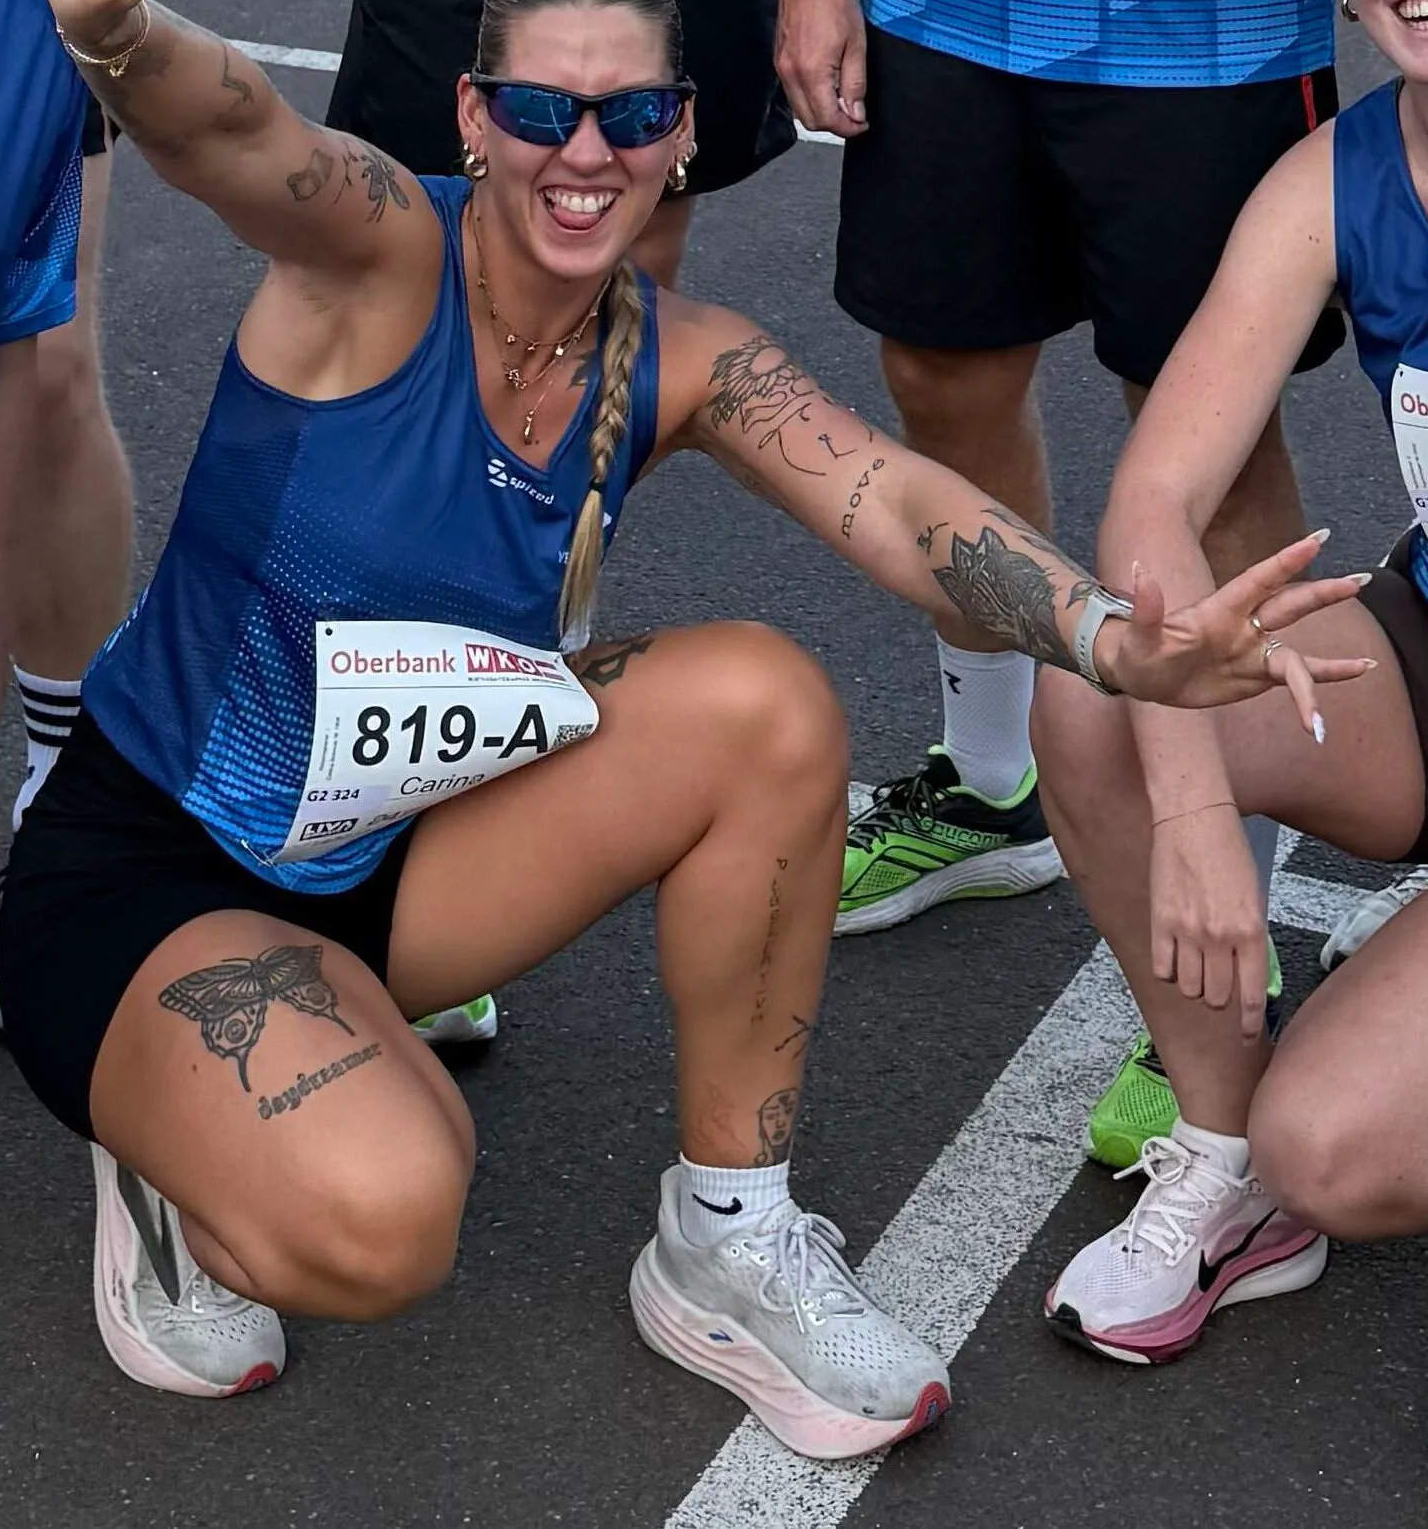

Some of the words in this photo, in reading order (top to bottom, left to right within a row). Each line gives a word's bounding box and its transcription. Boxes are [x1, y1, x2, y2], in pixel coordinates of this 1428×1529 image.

[330, 649, 457, 675] Oberbank
[467, 645, 537, 677] WKO
[352, 703, 549, 767] 819-A
[307, 789, 329, 803] G2
[332, 788, 360, 802] 324
[400, 773, 486, 796] Carina
